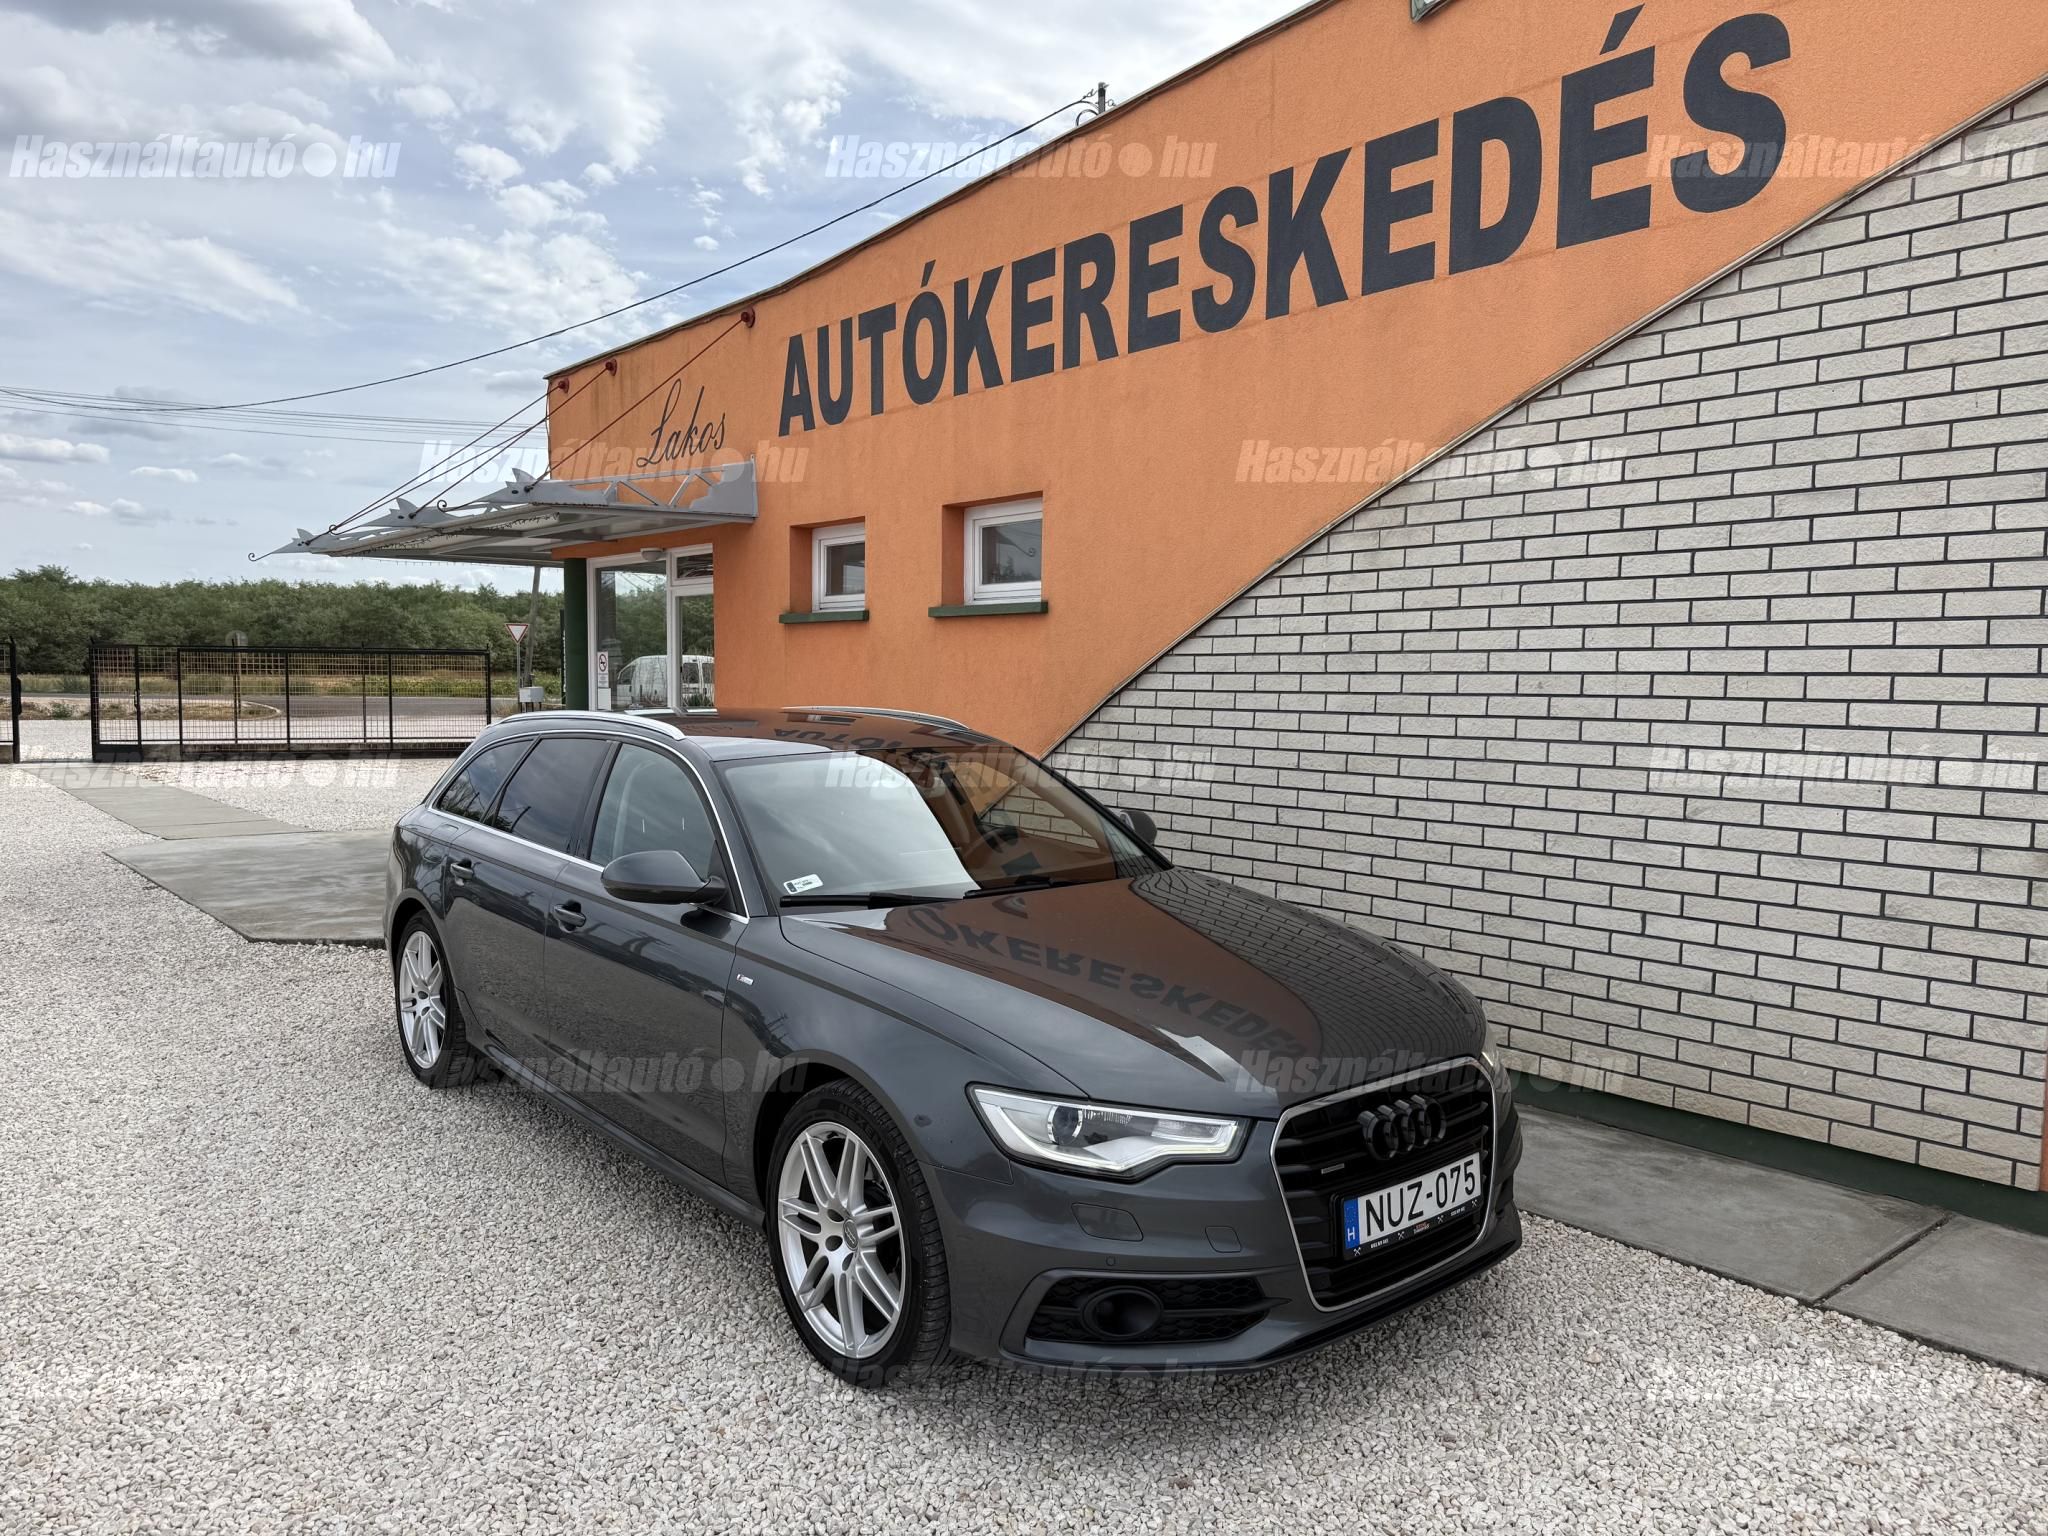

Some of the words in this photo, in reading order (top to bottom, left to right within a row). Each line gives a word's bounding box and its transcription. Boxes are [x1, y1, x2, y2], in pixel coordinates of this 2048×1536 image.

[636, 378, 726, 468] Lakos
[778, 3, 1791, 437] AUTÓKERESKEDÉS
[1347, 1226, 1356, 1242] H
[1365, 1159, 1476, 1237] NUZ-075
